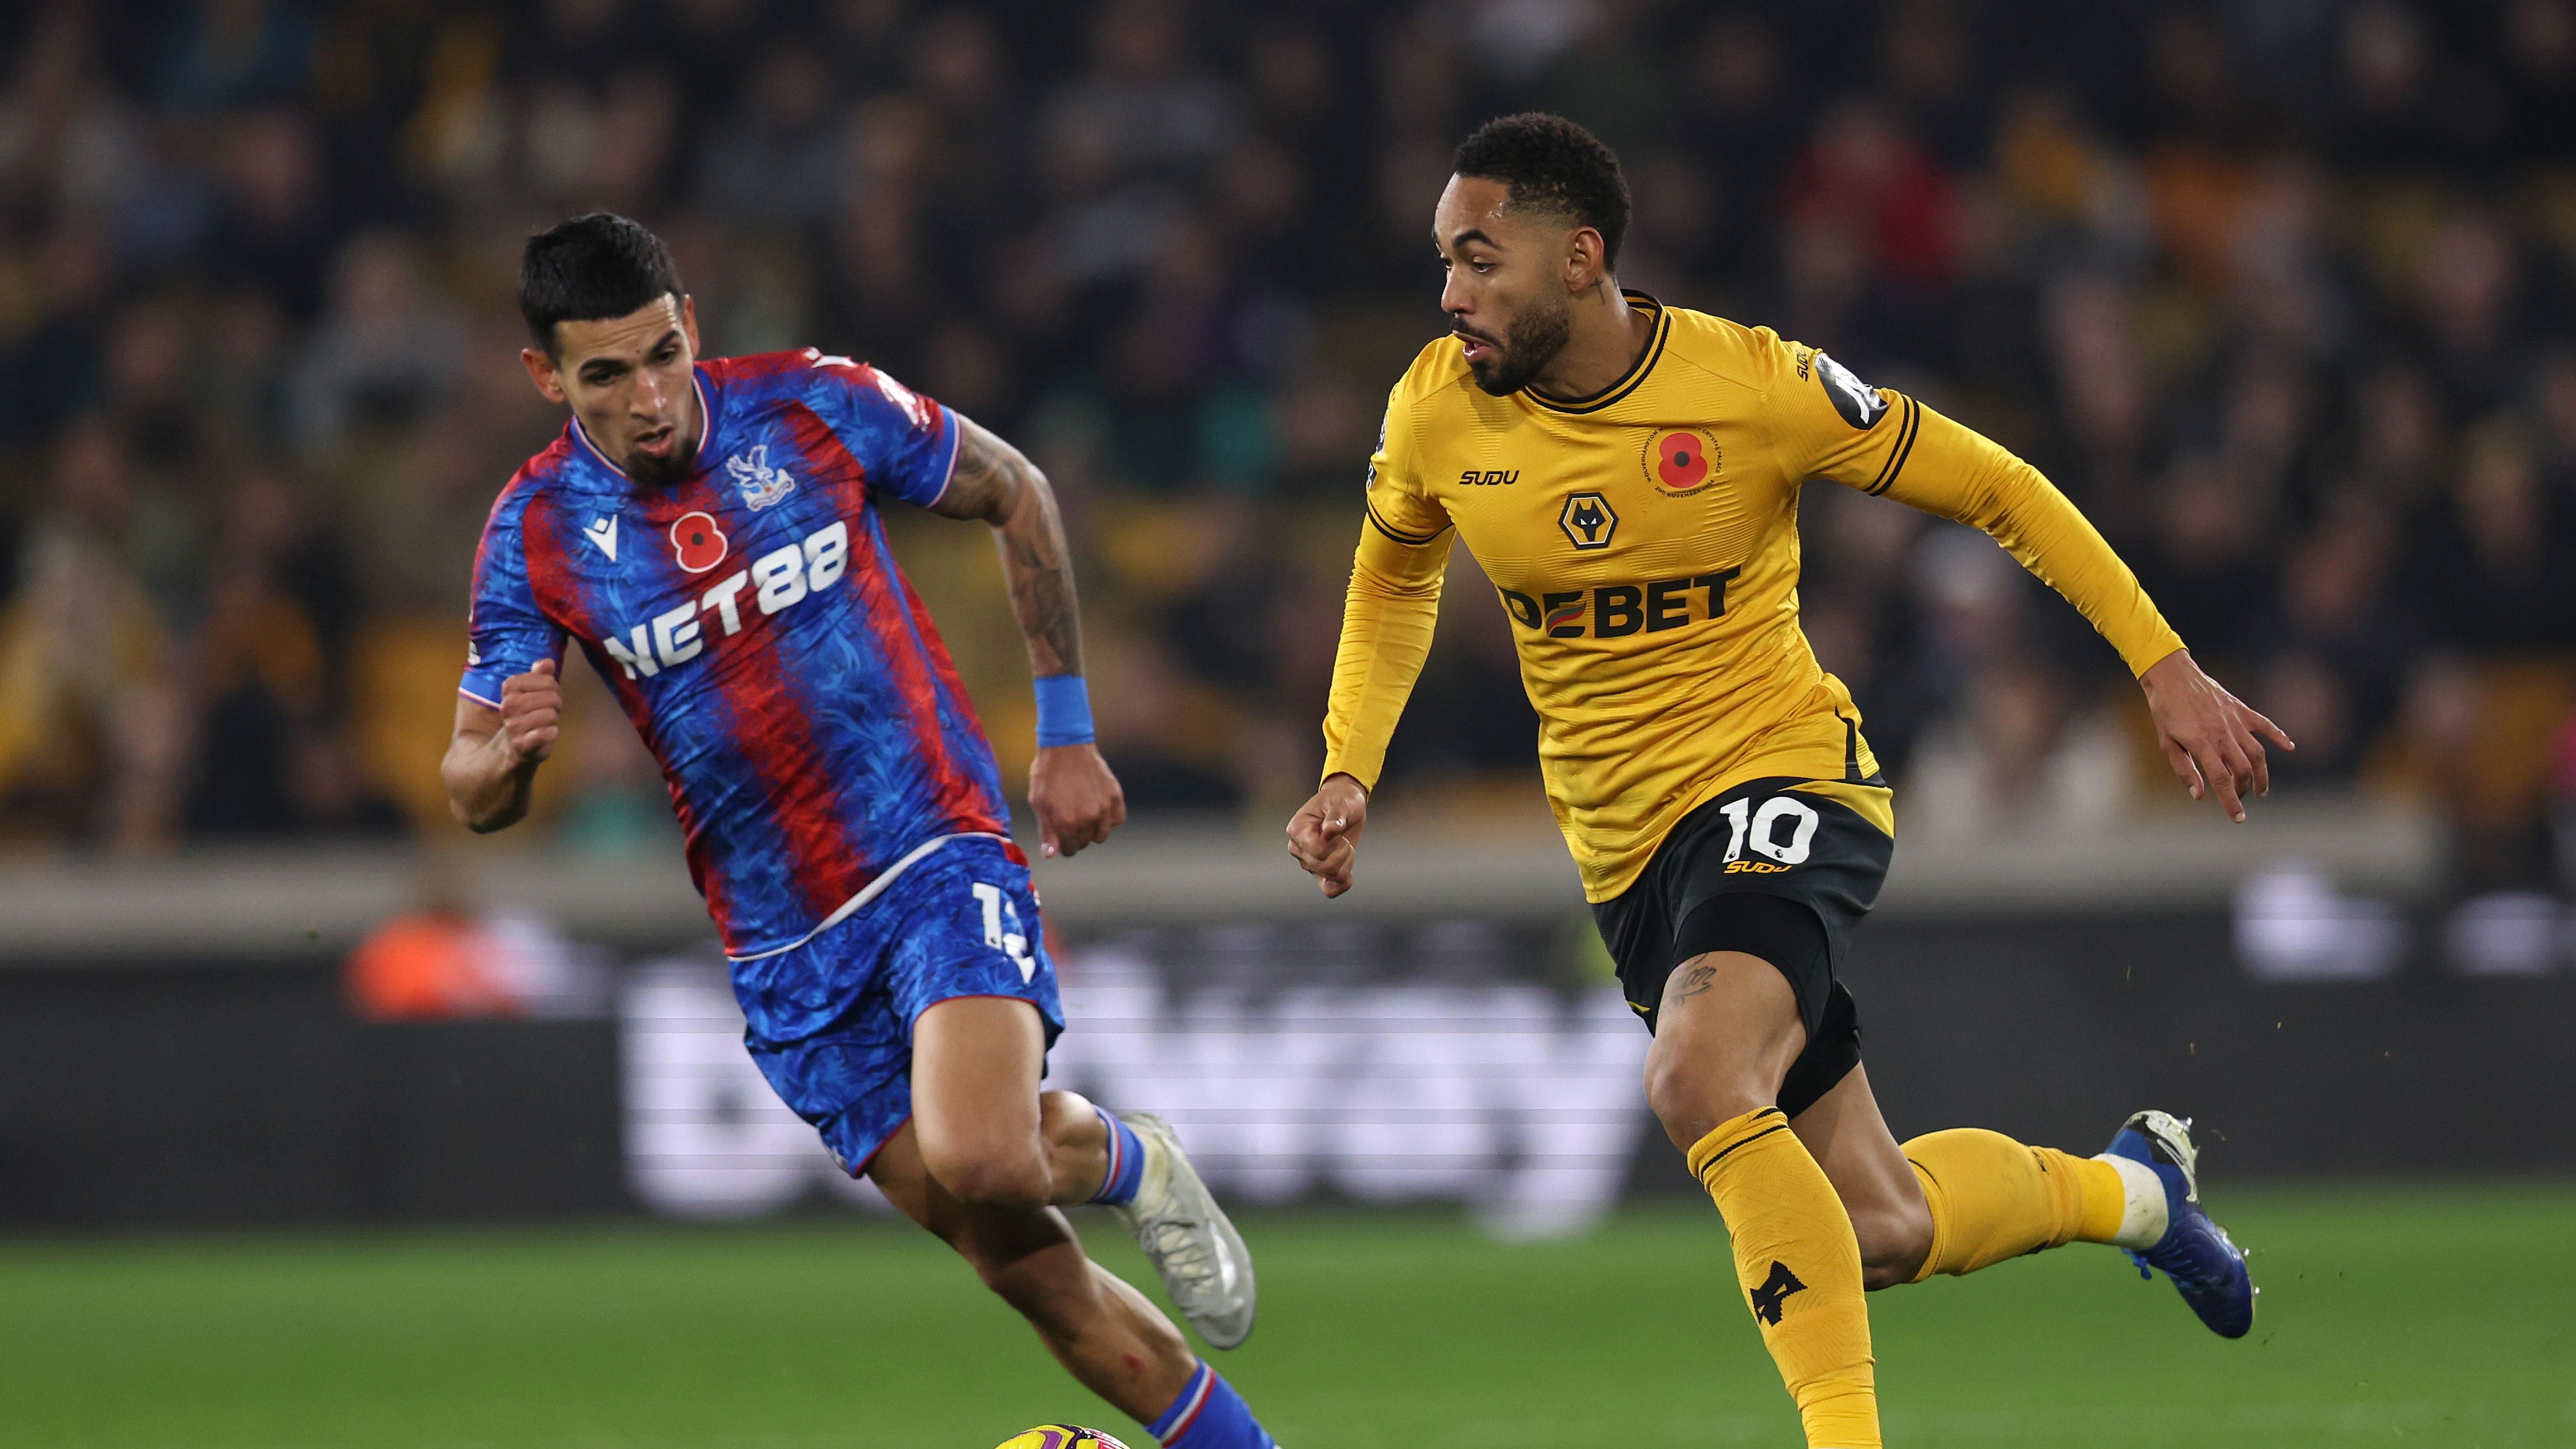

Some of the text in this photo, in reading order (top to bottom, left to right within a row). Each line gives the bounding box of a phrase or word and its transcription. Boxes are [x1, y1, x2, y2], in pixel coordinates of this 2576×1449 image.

[1459, 470, 1520, 485] SUDU
[1641, 430, 1658, 483] WOLVERHAMPTON
[603, 520, 847, 680] NET88
[1497, 565, 1741, 638] DEBET
[1720, 797, 1818, 864] 10
